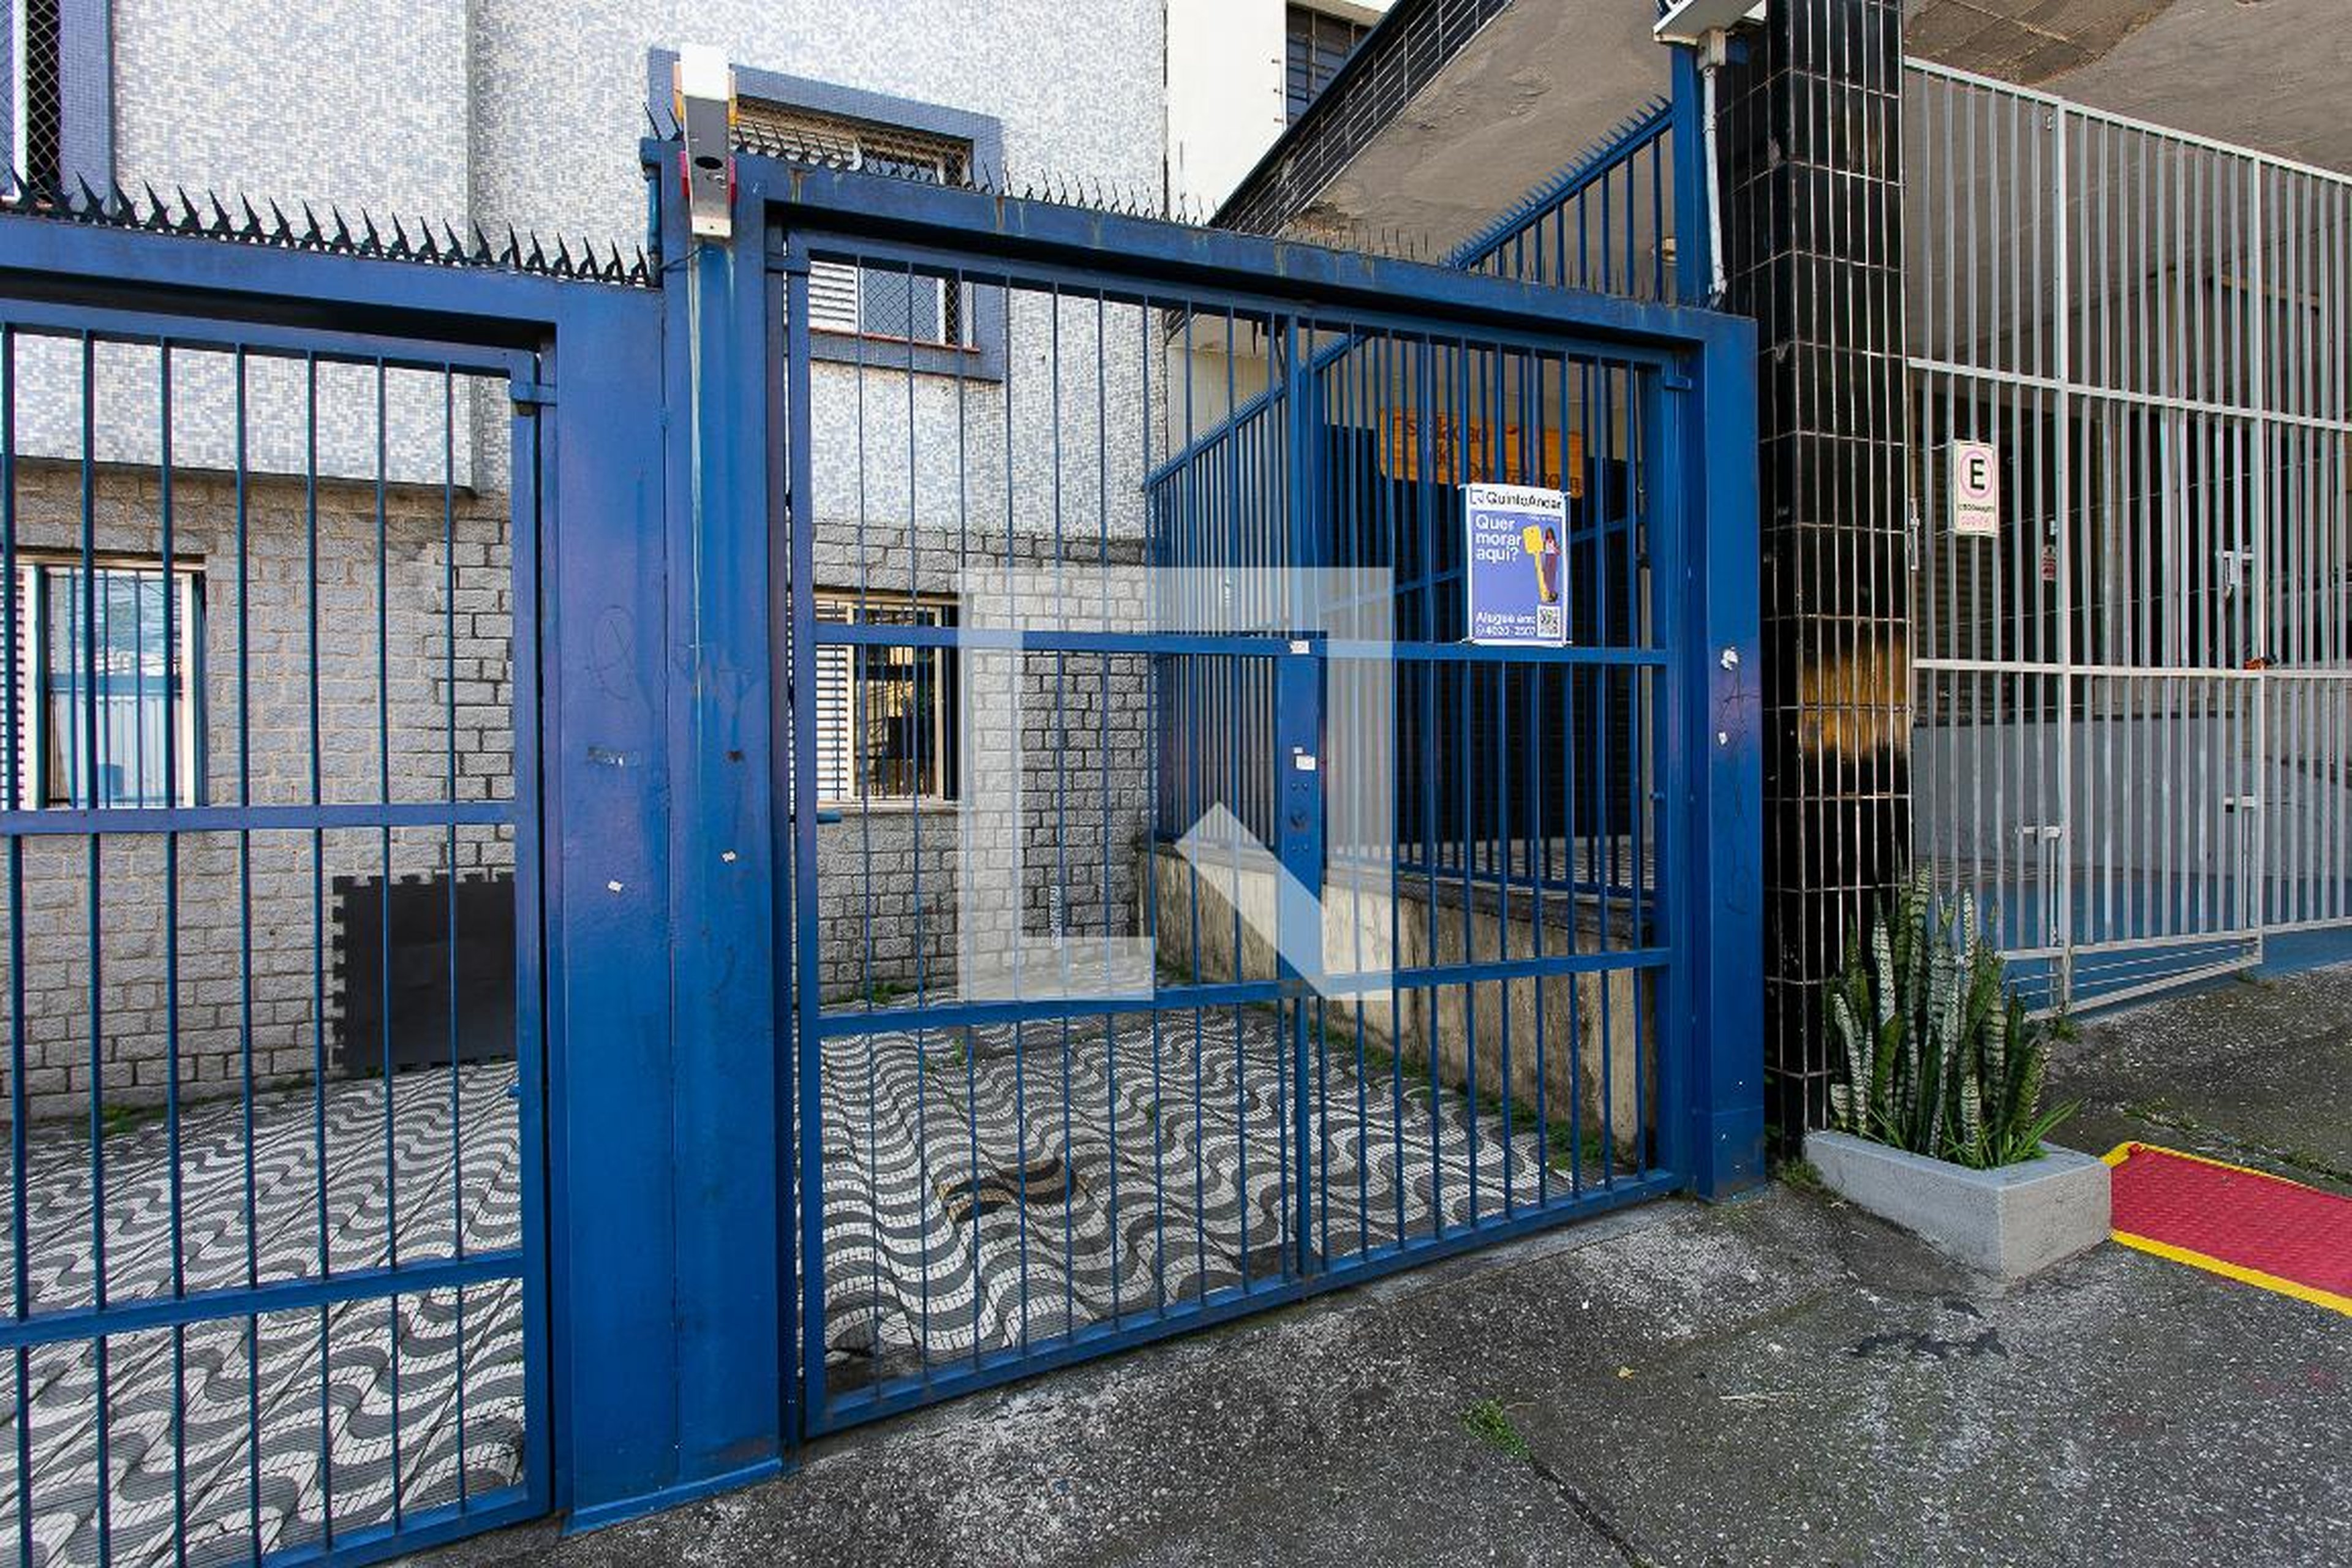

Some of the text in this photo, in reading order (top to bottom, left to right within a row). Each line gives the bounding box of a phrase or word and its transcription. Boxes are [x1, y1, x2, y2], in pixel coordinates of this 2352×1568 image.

[1970, 459, 1985, 490] E
[1476, 514, 1515, 531] Quer
[1476, 533, 1522, 546] morar
[1476, 545, 1519, 564] aqui?
